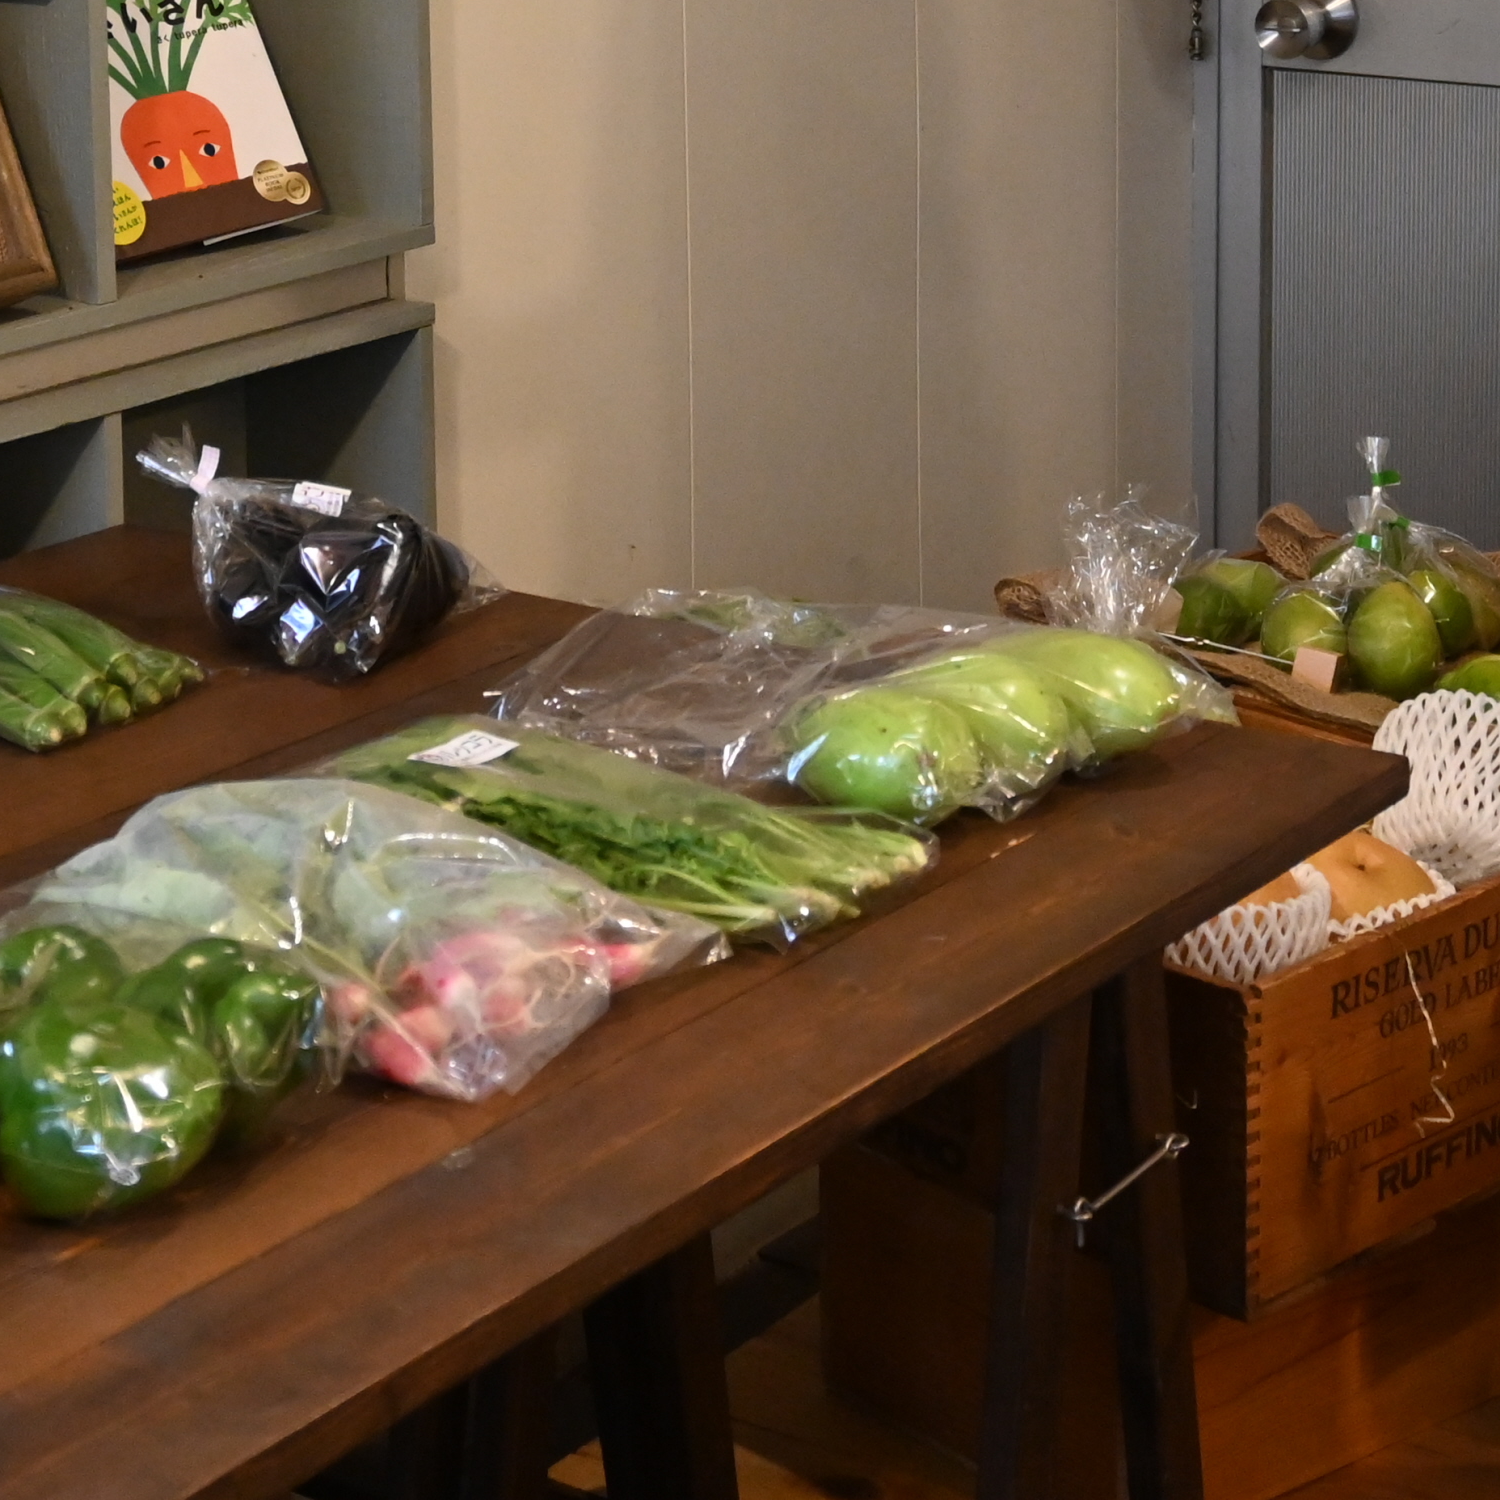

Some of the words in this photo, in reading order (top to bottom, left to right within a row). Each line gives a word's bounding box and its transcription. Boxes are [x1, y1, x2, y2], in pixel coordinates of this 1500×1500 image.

[174, 26, 208, 41] tupera
[211, 18, 246, 32] tupera
[1330, 933, 1458, 1020] RISERVA
[1378, 992, 1437, 1039] GOLD
